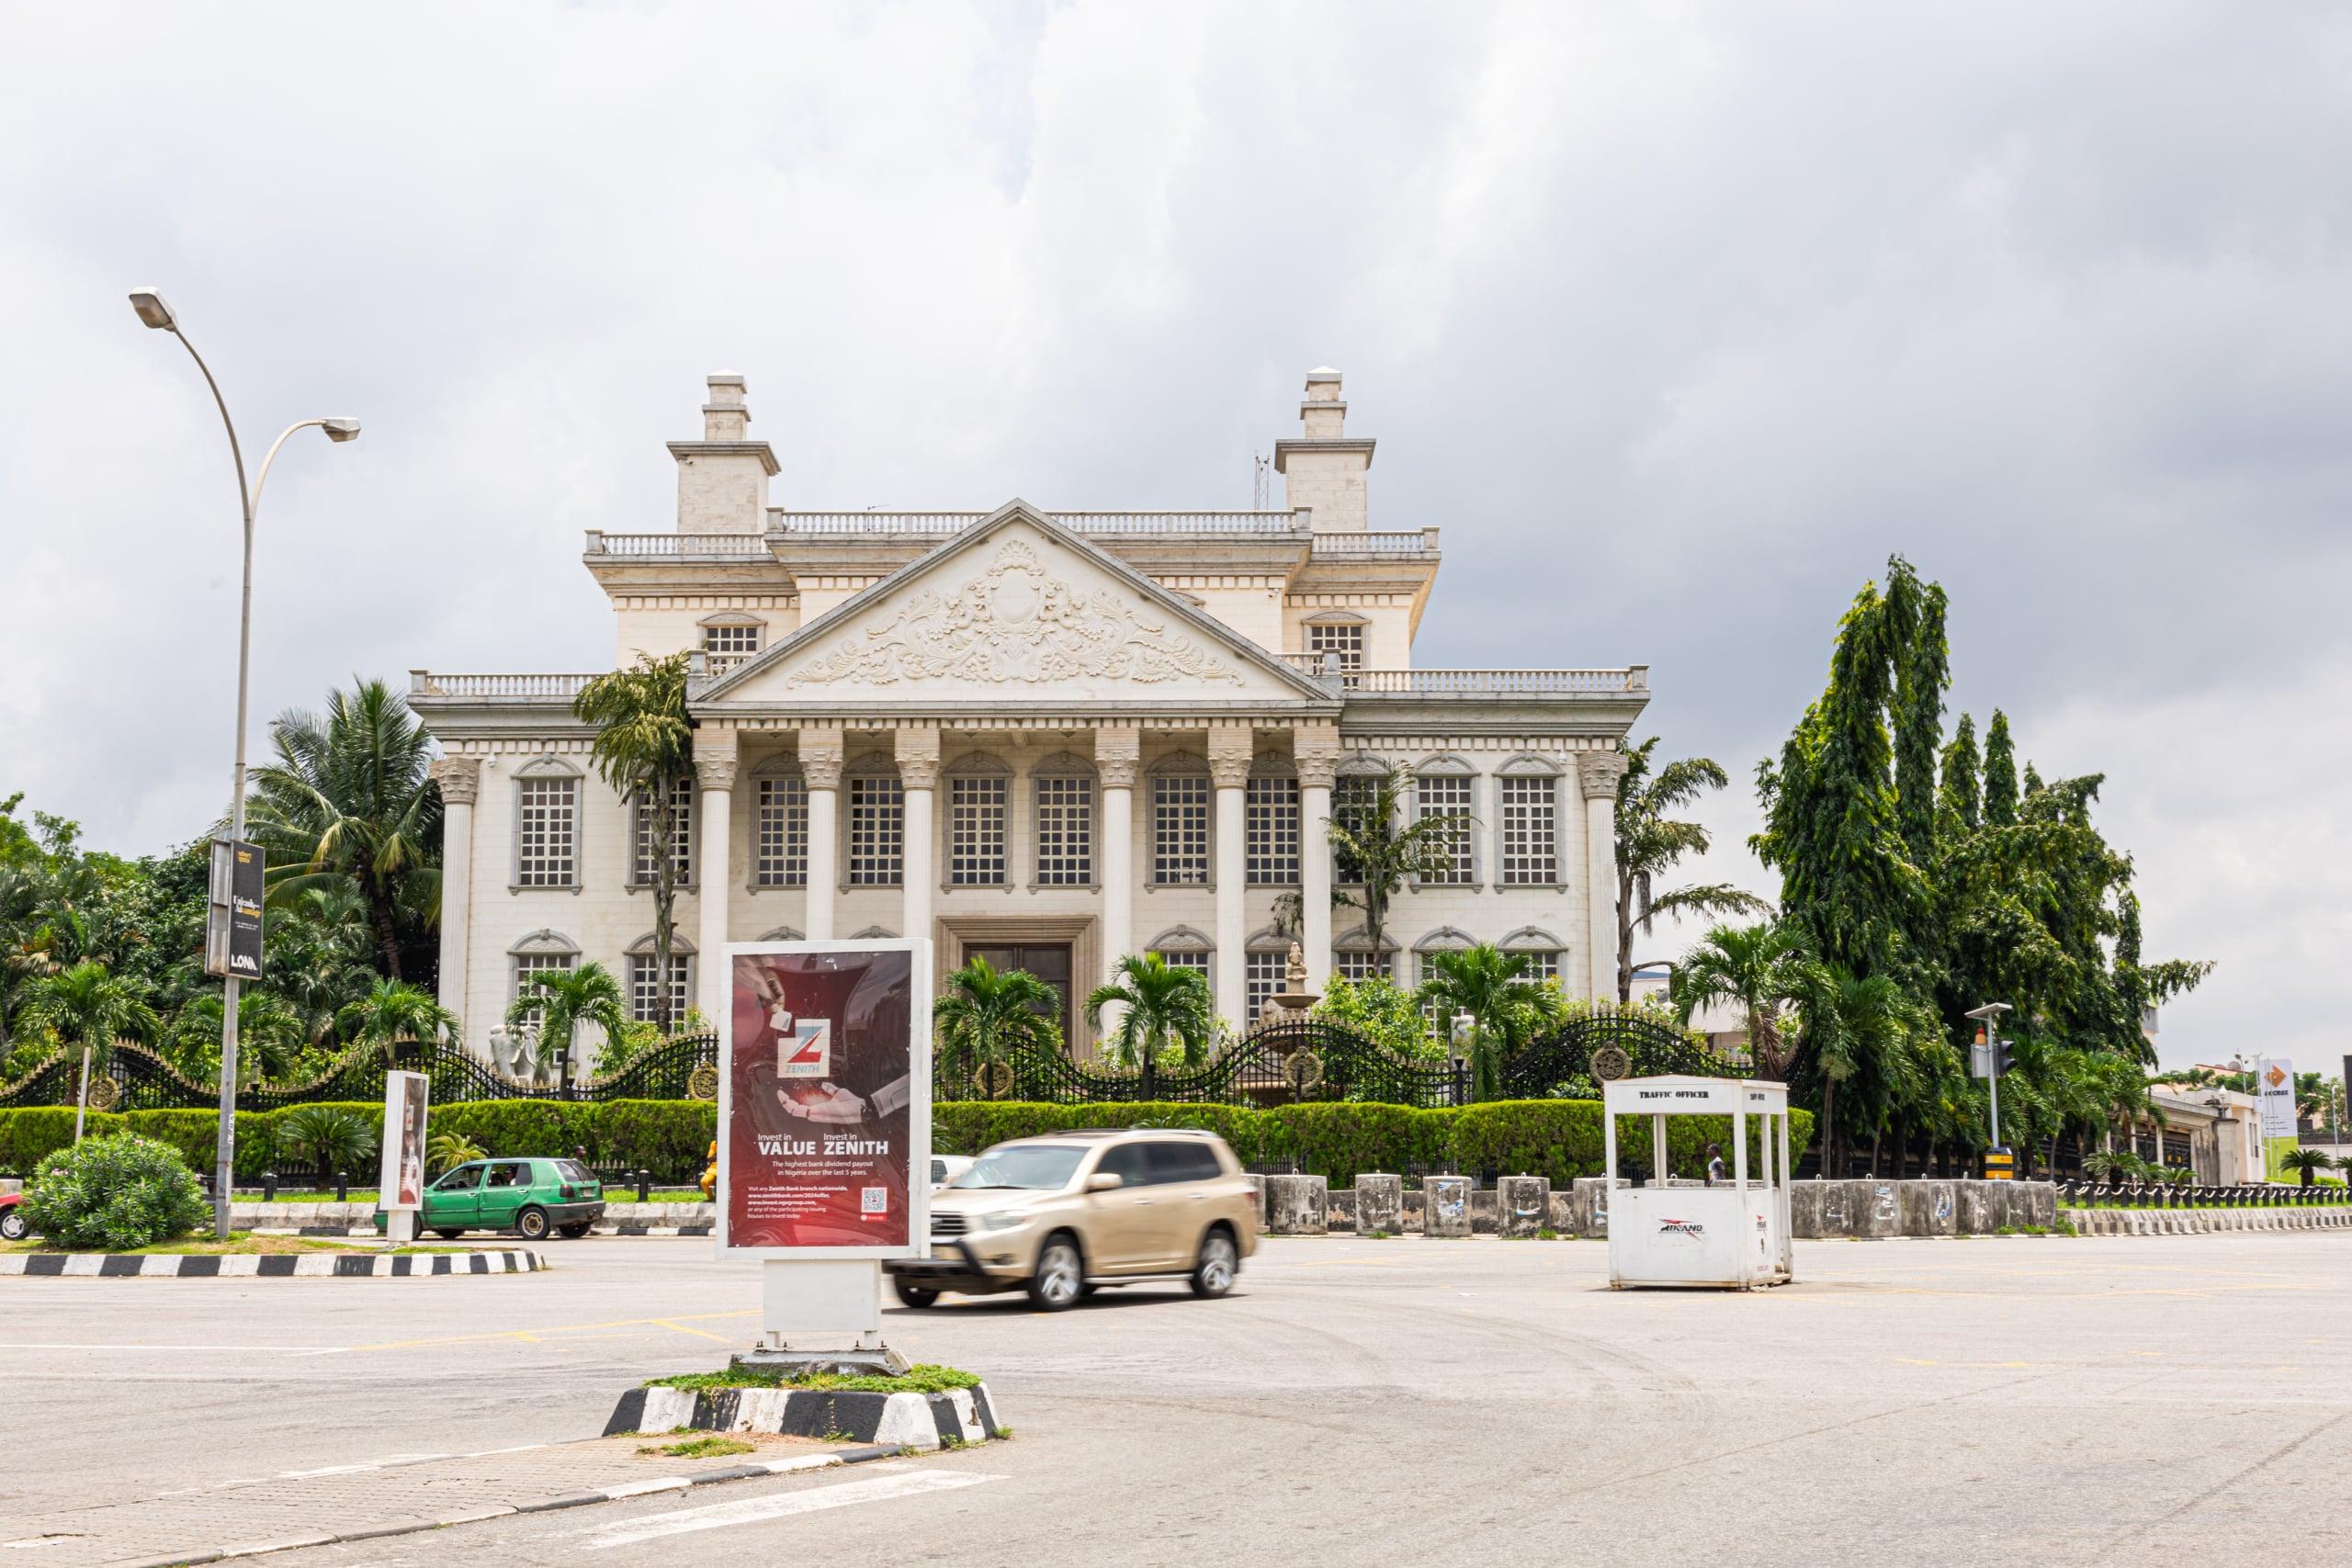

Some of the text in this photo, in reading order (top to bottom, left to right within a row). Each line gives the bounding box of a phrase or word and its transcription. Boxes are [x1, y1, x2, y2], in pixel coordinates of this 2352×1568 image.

[786, 1065, 820, 1074] ZENITH
[1639, 1090, 1710, 1099] TRAFFIC OFFICER
[758, 1133, 792, 1141] Invest in
[823, 1133, 848, 1141] Invest
[758, 1141, 816, 1155] VALUE
[823, 1140, 888, 1155] ZENITH
[785, 1160, 808, 1169] highest
[852, 1161, 874, 1169] payout
[785, 1169, 807, 1178] Nigeria
